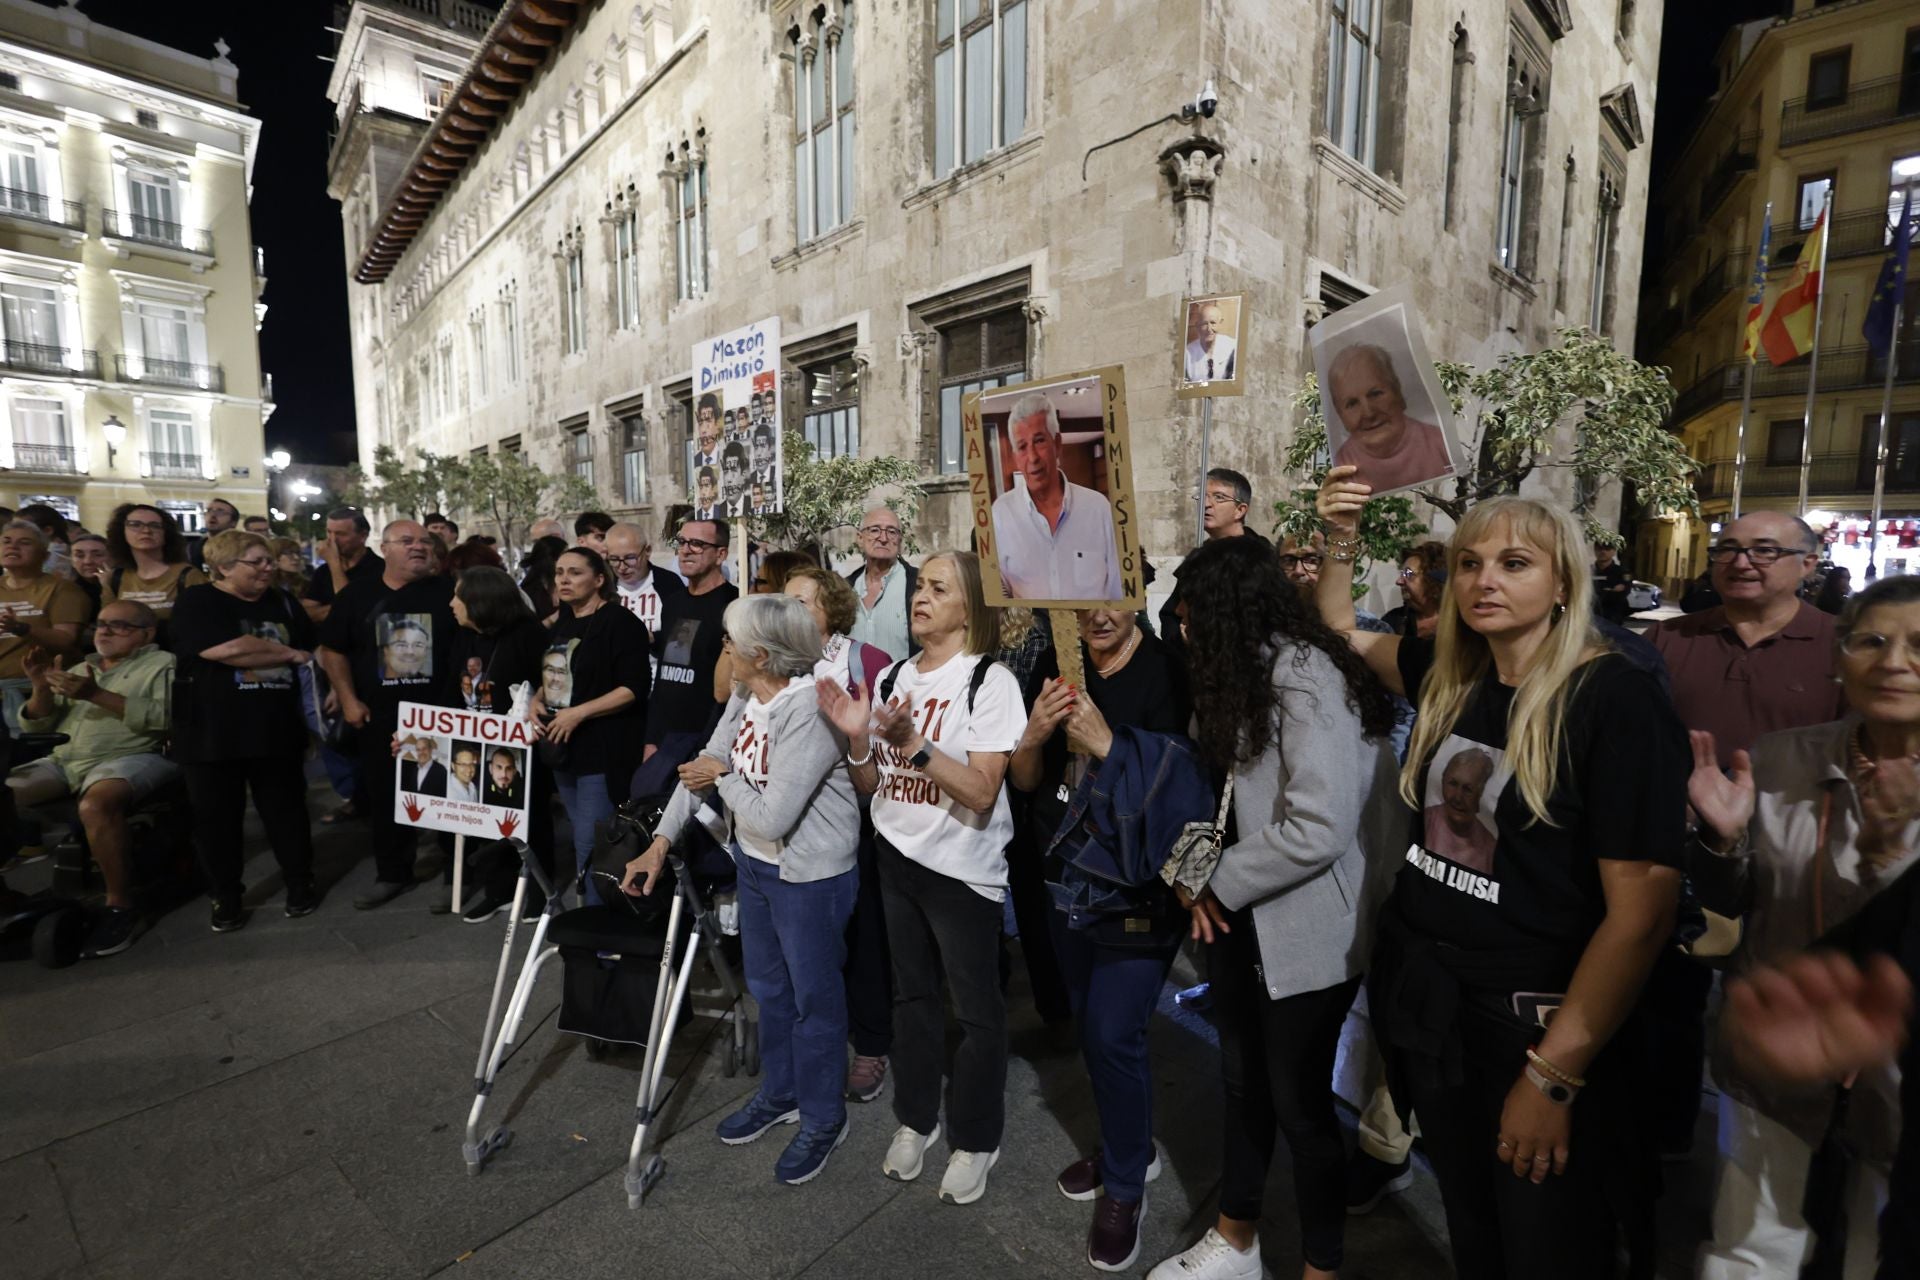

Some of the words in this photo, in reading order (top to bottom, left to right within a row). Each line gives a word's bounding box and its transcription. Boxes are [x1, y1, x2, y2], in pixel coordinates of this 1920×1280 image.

[711, 324, 764, 363] Mazón
[701, 350, 764, 391] Dimissió
[964, 412, 990, 559] MAZÓN
[402, 707, 527, 745] JUSTICIA
[430, 799, 444, 808] por
[447, 801, 458, 809] mi
[460, 803, 491, 815] marido
[444, 812, 460, 821] mis
[462, 814, 483, 825] hijos
[1446, 866, 1500, 905] LUISA
